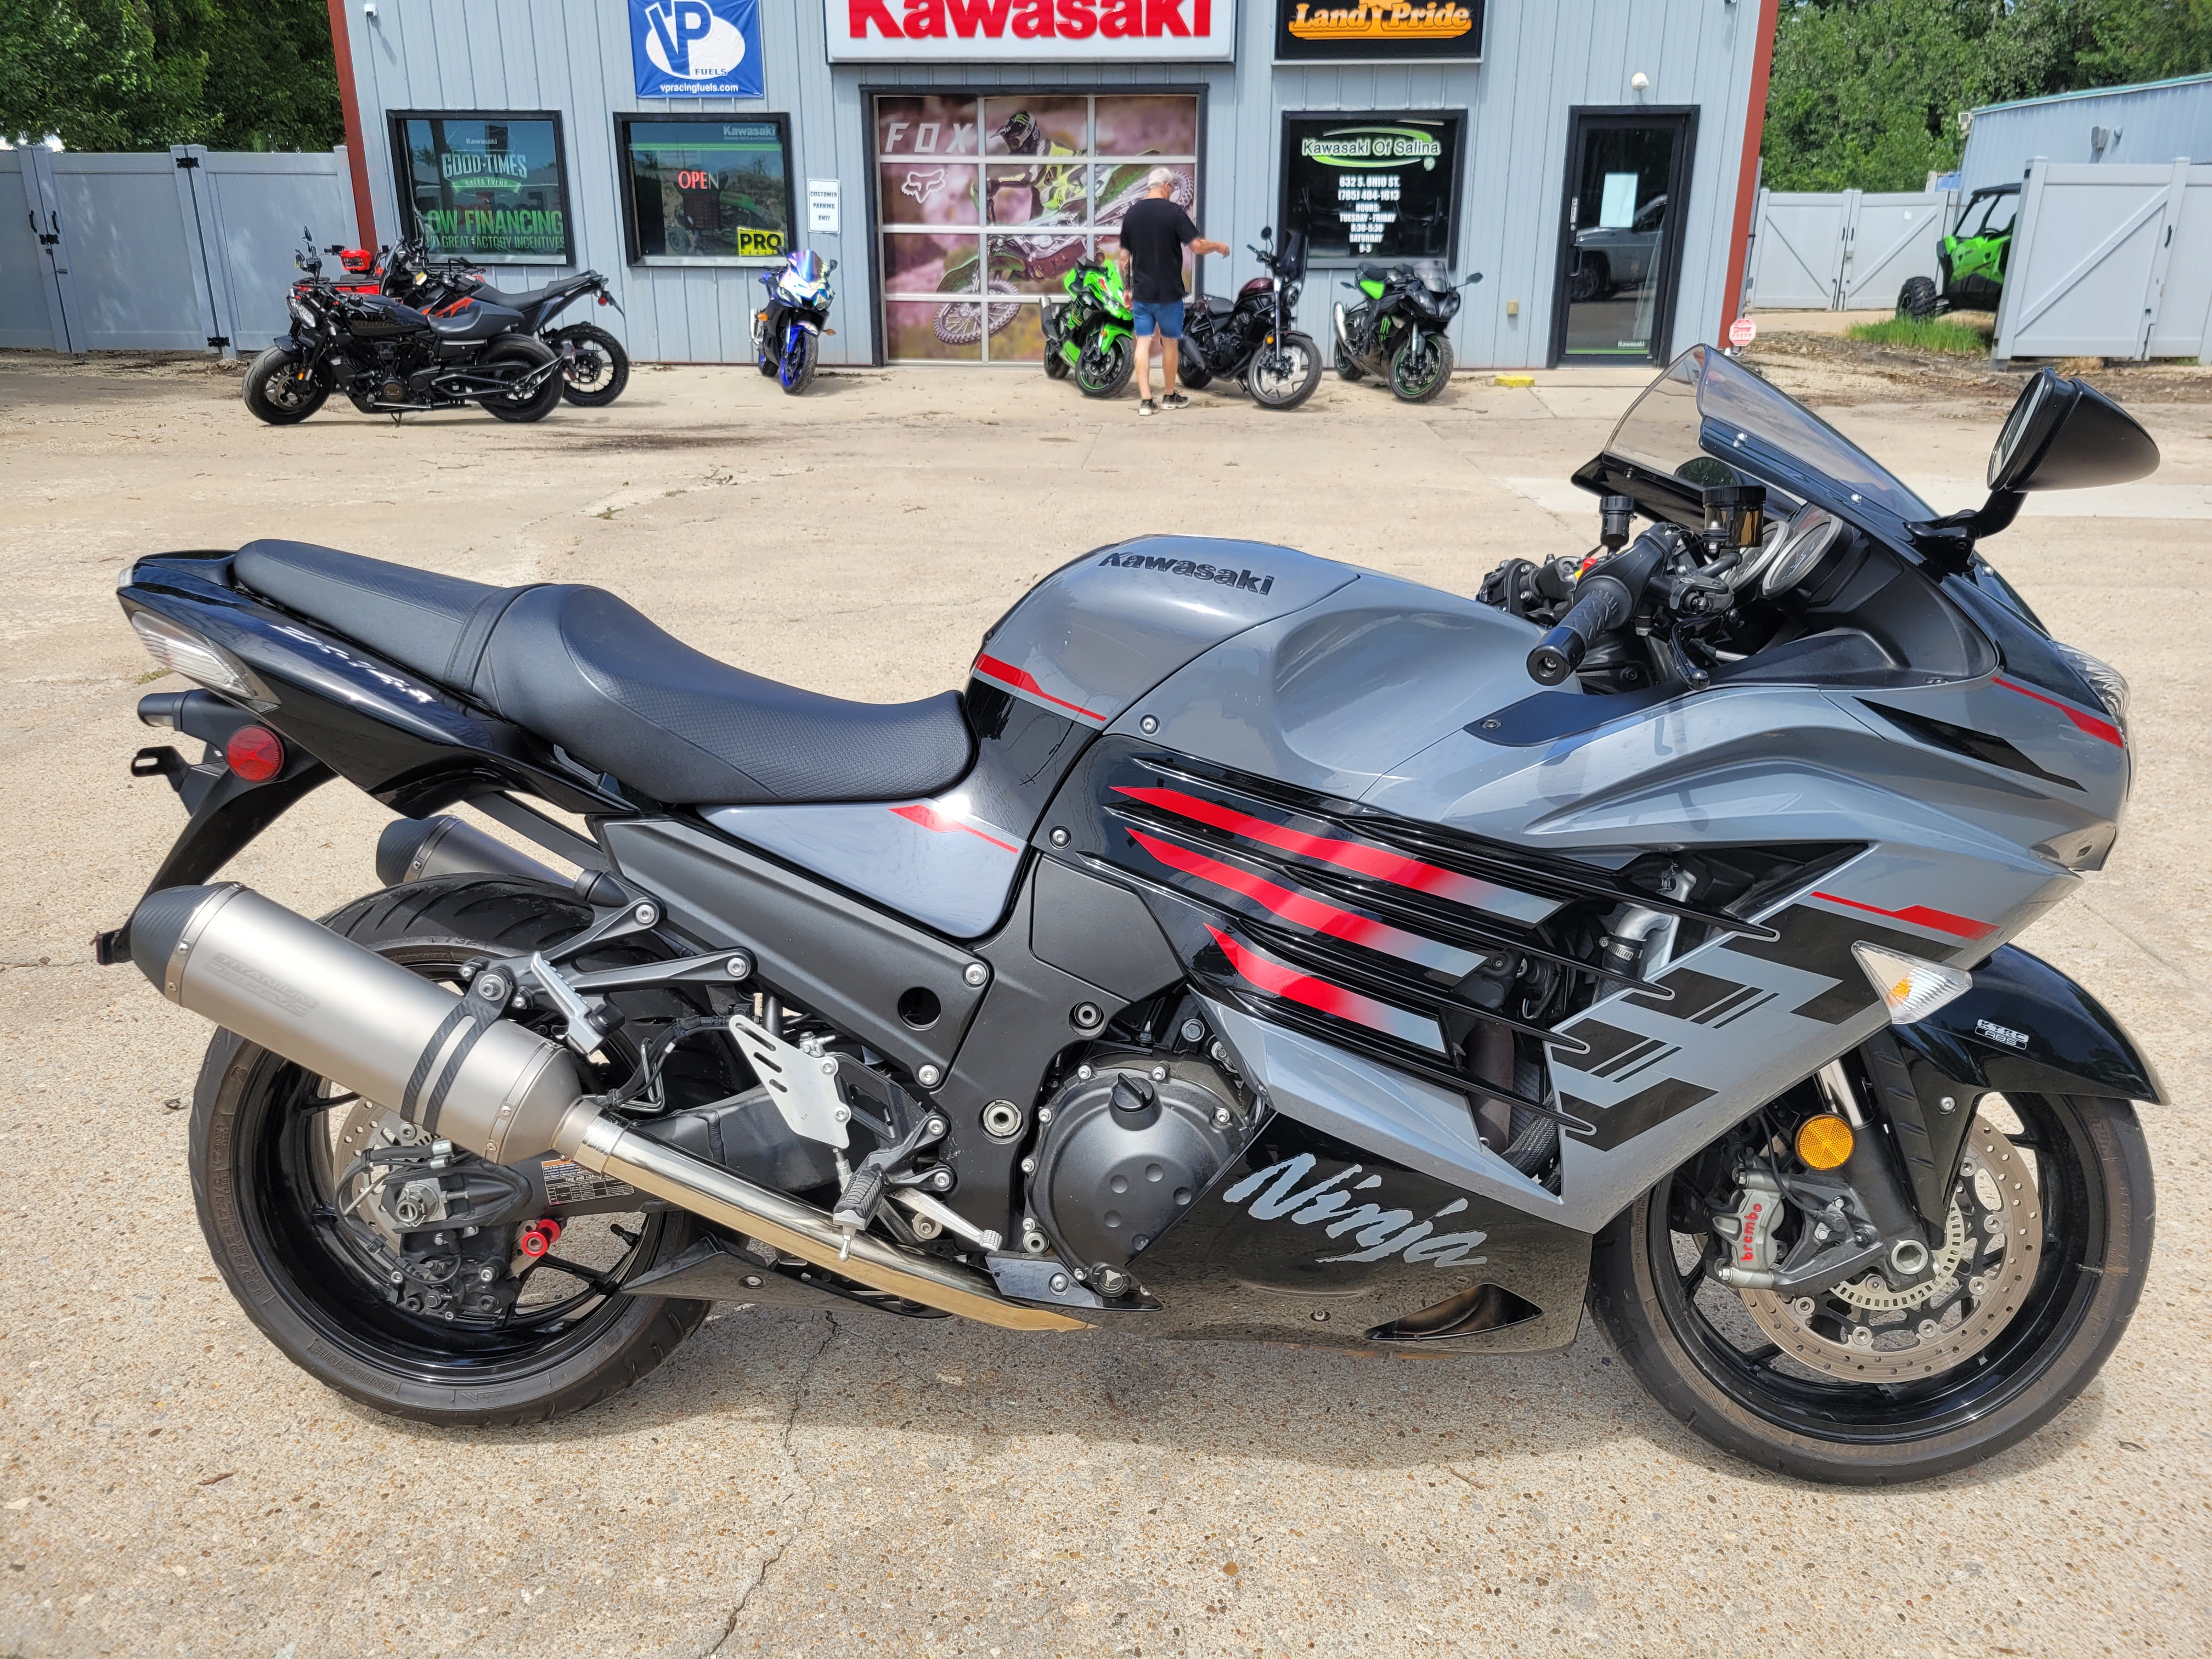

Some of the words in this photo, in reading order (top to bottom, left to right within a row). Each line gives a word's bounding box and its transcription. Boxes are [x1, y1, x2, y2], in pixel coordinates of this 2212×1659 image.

[849, 0, 1211, 38] Kawasaki
[1293, 2, 1367, 28] Land
[1387, 2, 1470, 27] Pride
[646, 0, 713, 77] VP
[660, 83, 738, 93] vpracingfuels.com
[723, 126, 776, 136] Kawasaki
[885, 123, 974, 154] FOX
[1303, 140, 1369, 155] Kawasaki
[1373, 140, 1392, 155] Of
[1394, 140, 1440, 155] Salina
[441, 154, 482, 178] GOOD
[485, 154, 527, 179] TIMES
[488, 178, 507, 187] EVENT
[678, 170, 719, 189] OPEN
[1339, 175, 1357, 187] 632
[1366, 175, 1387, 187] OHIO
[1338, 188, 1361, 201] (785)
[427, 210, 458, 234] OW
[464, 210, 564, 235] FINANCING
[1339, 212, 1369, 223] TUESDAY
[1372, 212, 1397, 223] FRIDAY
[442, 235, 469, 249] GREAT
[471, 235, 512, 249] FACTORY
[515, 236, 565, 249] INCENTIVES
[741, 233, 782, 250] PRO
[1350, 232, 1384, 243] SATURDAY
[1098, 552, 1274, 596] Kawasaki
[221, 955, 317, 1007] TITANIUM
[1985, 1031, 2017, 1046] ABS
[1222, 1152, 1488, 1268] Ninja
[1740, 1203, 1762, 1261] brembo
[311, 1344, 397, 1395] BRIDGESTONE
